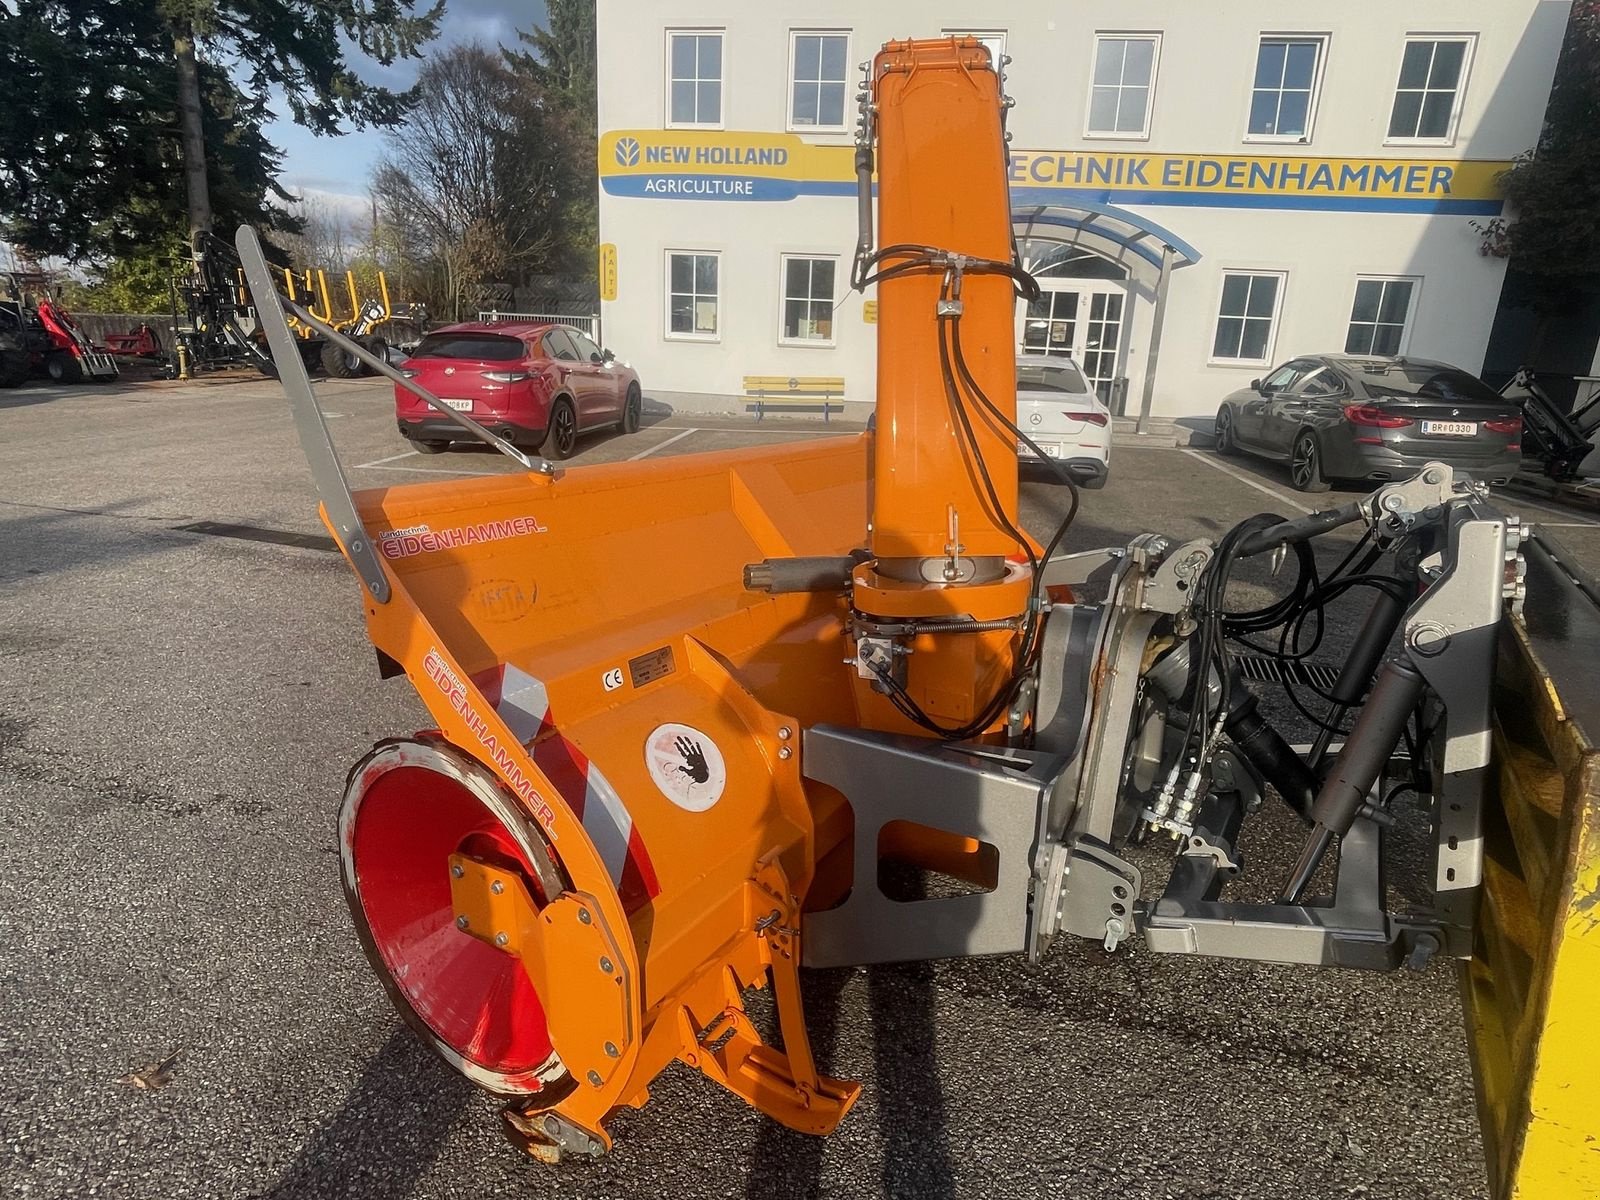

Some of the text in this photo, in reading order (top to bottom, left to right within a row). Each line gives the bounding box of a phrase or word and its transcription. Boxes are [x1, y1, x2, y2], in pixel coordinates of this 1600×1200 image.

[646, 146, 788, 166] NEW HOLLAND
[645, 179, 753, 195] AGRICULTURE
[1161, 159, 1454, 194] EIDENHAMMER
[379, 525, 429, 538] Landtechnik
[383, 517, 538, 558] EIDENHAMMER
[430, 647, 467, 694] Landtechnik
[605, 670, 622, 688] CE
[424, 655, 556, 828] EIDENHAMMER
